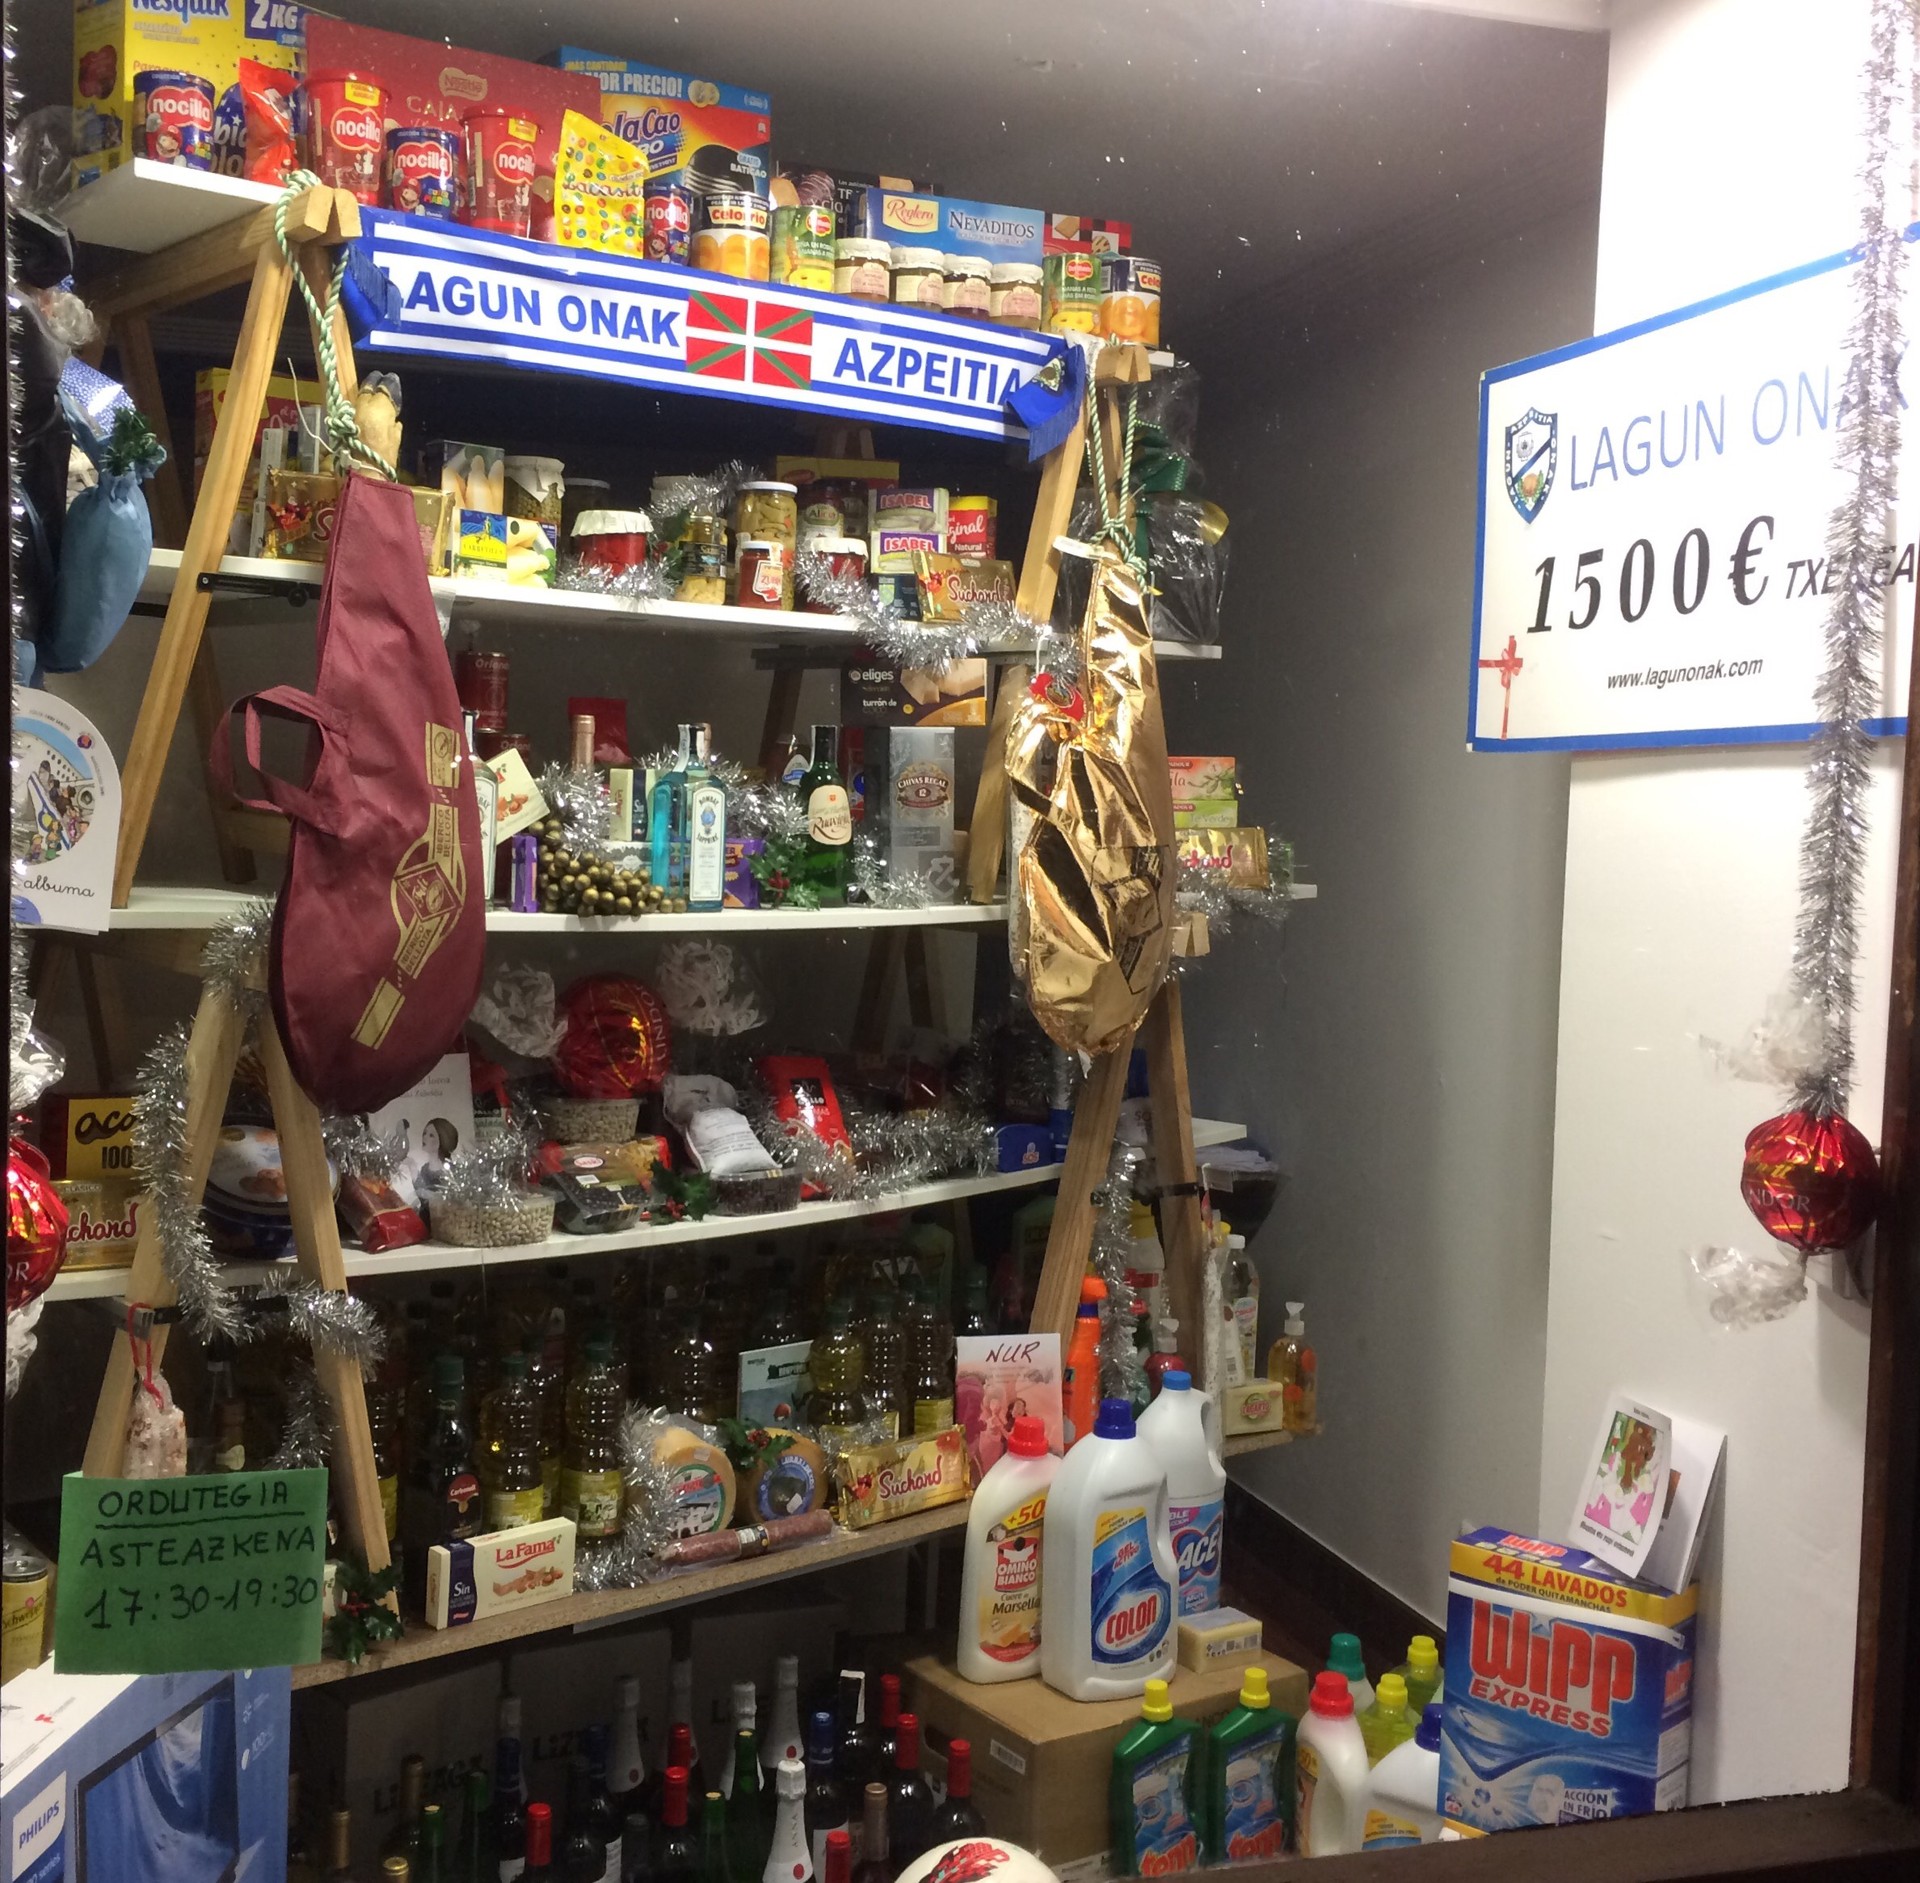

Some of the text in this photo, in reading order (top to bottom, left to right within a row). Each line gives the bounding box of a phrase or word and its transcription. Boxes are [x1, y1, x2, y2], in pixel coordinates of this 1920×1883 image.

[623, 72, 683, 98] PRECIO!
[152, 98, 211, 123] nocilla
[336, 116, 381, 143] nocilla
[397, 148, 449, 173] nocilla
[646, 204, 689, 224] noclla
[711, 208, 766, 225] Celorio
[949, 211, 1035, 239] NEVADITOS
[380, 265, 681, 348] AGUN ONAK
[833, 336, 1021, 406] AZPEITIA
[1570, 393, 1727, 492] LAGUN
[881, 493, 930, 510] ISABEL
[884, 537, 936, 551] ISABEL
[955, 543, 982, 551] Natural
[946, 575, 1001, 603] Suchard
[862, 668, 894, 683] eliges
[1607, 657, 1764, 690] www.lagunonak.com
[863, 697, 897, 707] turrón de
[898, 776, 947, 789] CHIVAS REGAL
[23, 874, 96, 898] albuma
[102, 1145, 138, 1170] 100
[1749, 1188, 1811, 1213] NDOR
[66, 1202, 140, 1243] chard
[985, 1341, 1041, 1363] NUR
[878, 1455, 943, 1500] Suchard
[98, 1480, 288, 1518] ORDUTEGIA
[80, 1526, 316, 1568] ASTEAZKENA
[496, 1538, 556, 1563] La Fama
[1178, 1522, 1221, 1572] ACE
[997, 1558, 1038, 1576] OMINO
[997, 1572, 1036, 1586] BIANCO
[453, 1581, 471, 1598] Sin
[1482, 1554, 1628, 1609] 44 LAVADOS
[1508, 1578, 1538, 1596] PODER
[1538, 1587, 1612, 1614] QUITAMANCHAS
[1105, 1594, 1158, 1645] COLON
[1470, 1677, 1612, 1739] EXPRESS
[1564, 1788, 1608, 1807] ACCIÓN
[1564, 1800, 1575, 1812] EN
[19, 1800, 60, 1850] PHILIPS
